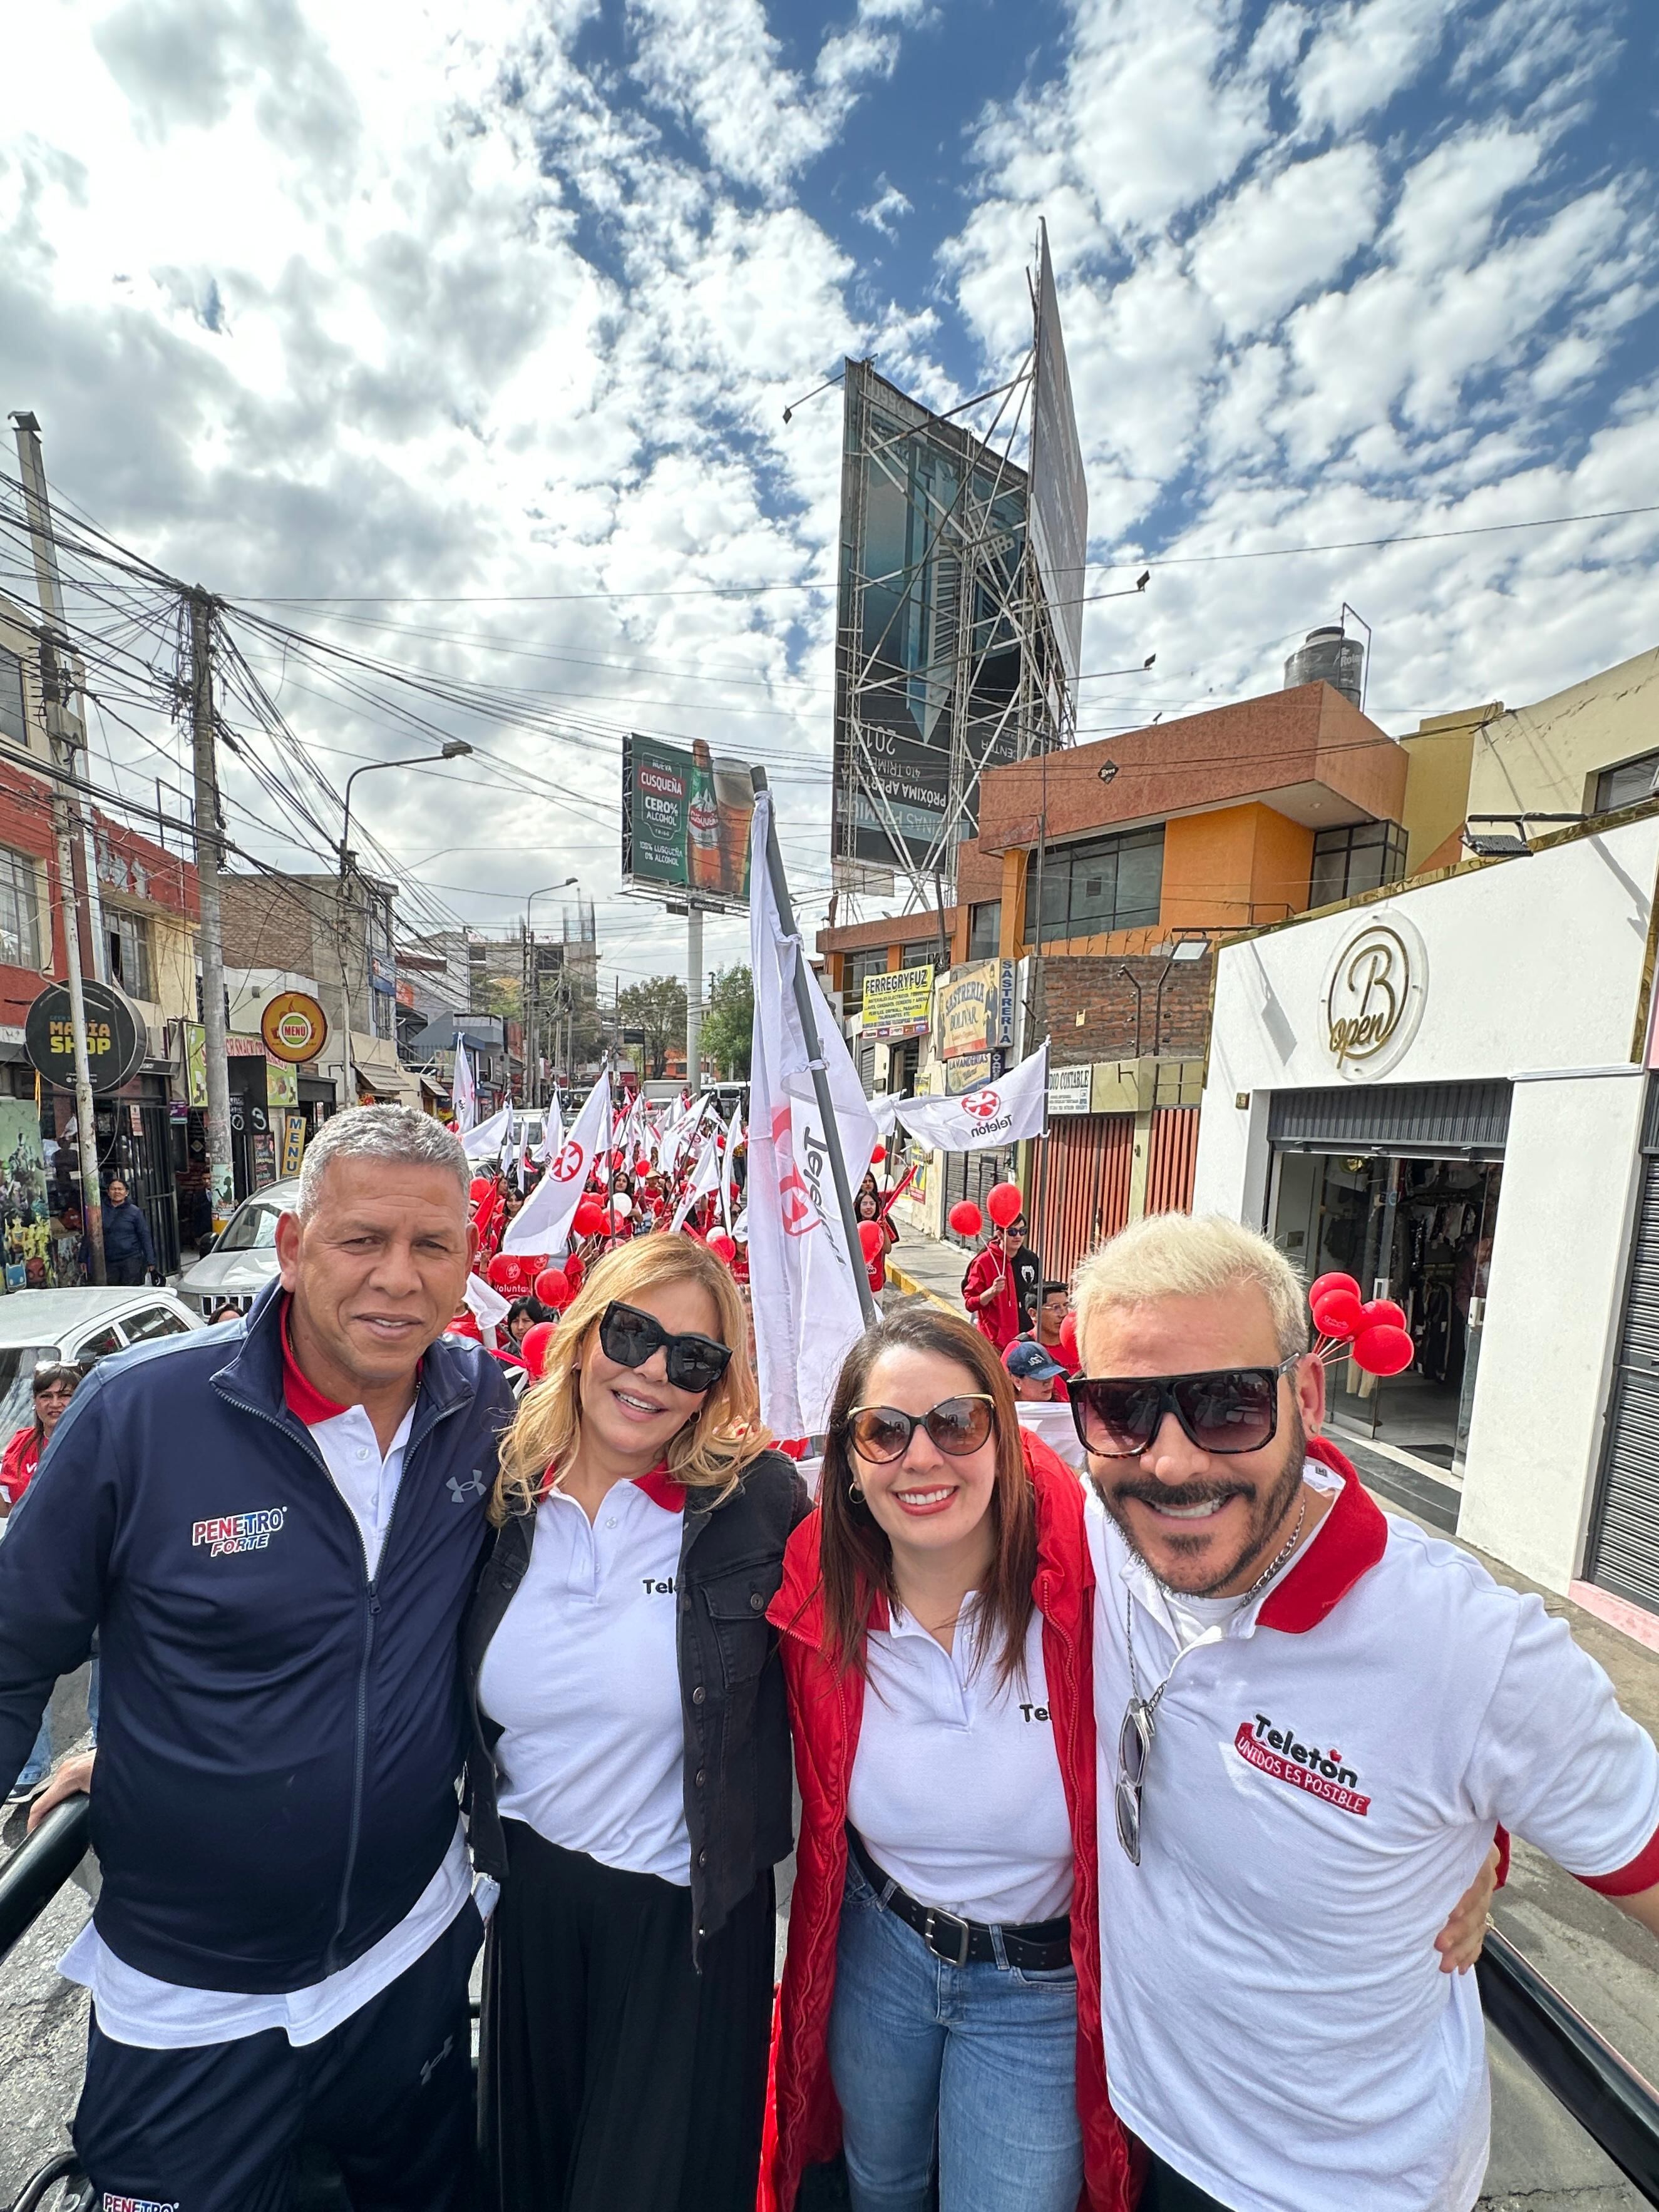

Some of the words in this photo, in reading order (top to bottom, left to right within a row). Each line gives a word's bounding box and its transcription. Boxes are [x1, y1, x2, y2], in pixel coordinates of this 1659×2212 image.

[652, 759, 672, 772] NUEVA
[640, 772, 682, 796] CUSQUEÑA
[901, 783, 946, 808] PRÓXIMA
[645, 796, 679, 817] CERO%
[646, 811, 677, 827] ALCOHOL
[654, 854, 679, 867] ALCOHOL
[1000, 961, 1013, 1043] SASTRERIA
[49, 1020, 111, 1037] MAÍA
[284, 1024, 306, 1037] MENÚ
[50, 1037, 111, 1055] SHOP
[286, 1118, 302, 1172] MENU
[494, 1283, 530, 1293] Volunta
[192, 1509, 284, 1546] PENETRO
[210, 1533, 270, 1558] FORTE
[642, 1577, 677, 1595] Tel
[1237, 1736, 1282, 1774] UNIDOS
[1285, 1764, 1302, 1783] ES
[1304, 1773, 1365, 1812] POSIBLE
